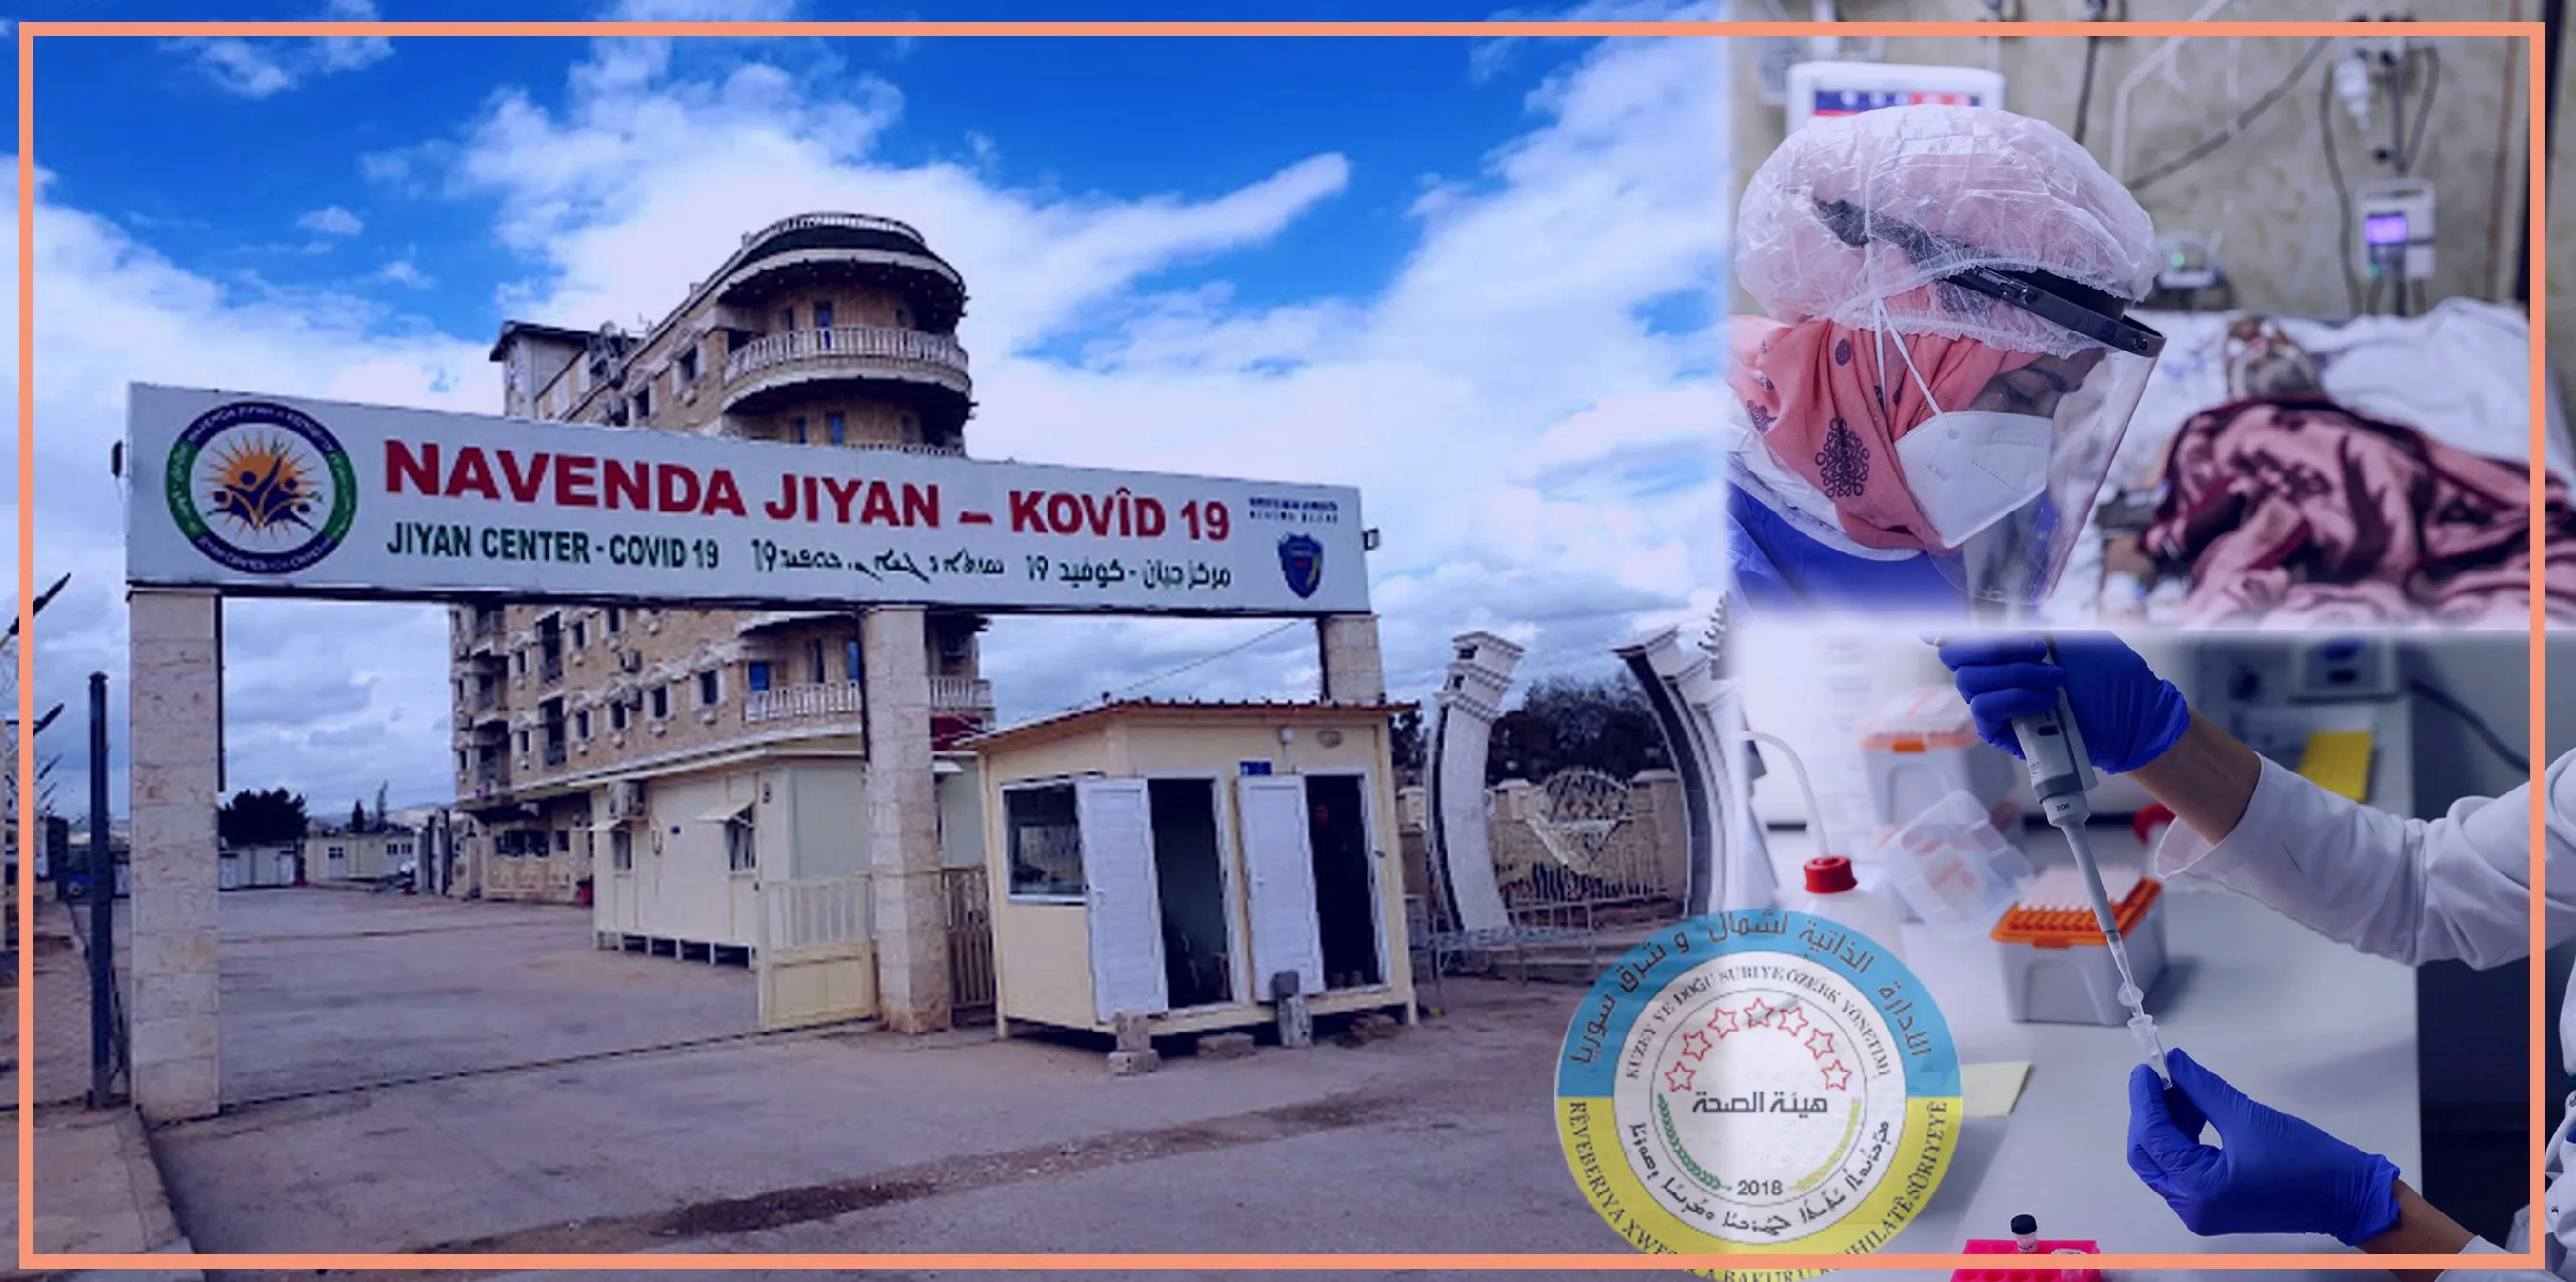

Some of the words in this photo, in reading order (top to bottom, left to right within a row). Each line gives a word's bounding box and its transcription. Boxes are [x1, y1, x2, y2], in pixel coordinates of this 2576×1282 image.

[385, 439, 747, 517] NAVENDA
[765, 473, 940, 528] JIYAN
[1009, 486, 1166, 537] KOVÎD
[1181, 500, 1230, 541] 19
[387, 522, 471, 557] JIYAN
[482, 528, 590, 564] CENTER
[610, 534, 686, 568] COVID
[693, 538, 719, 569] 19
[1059, 557, 1125, 588] كوفيد
[1143, 558, 1185, 590] جيان
[1188, 559, 1231, 590] مركز
